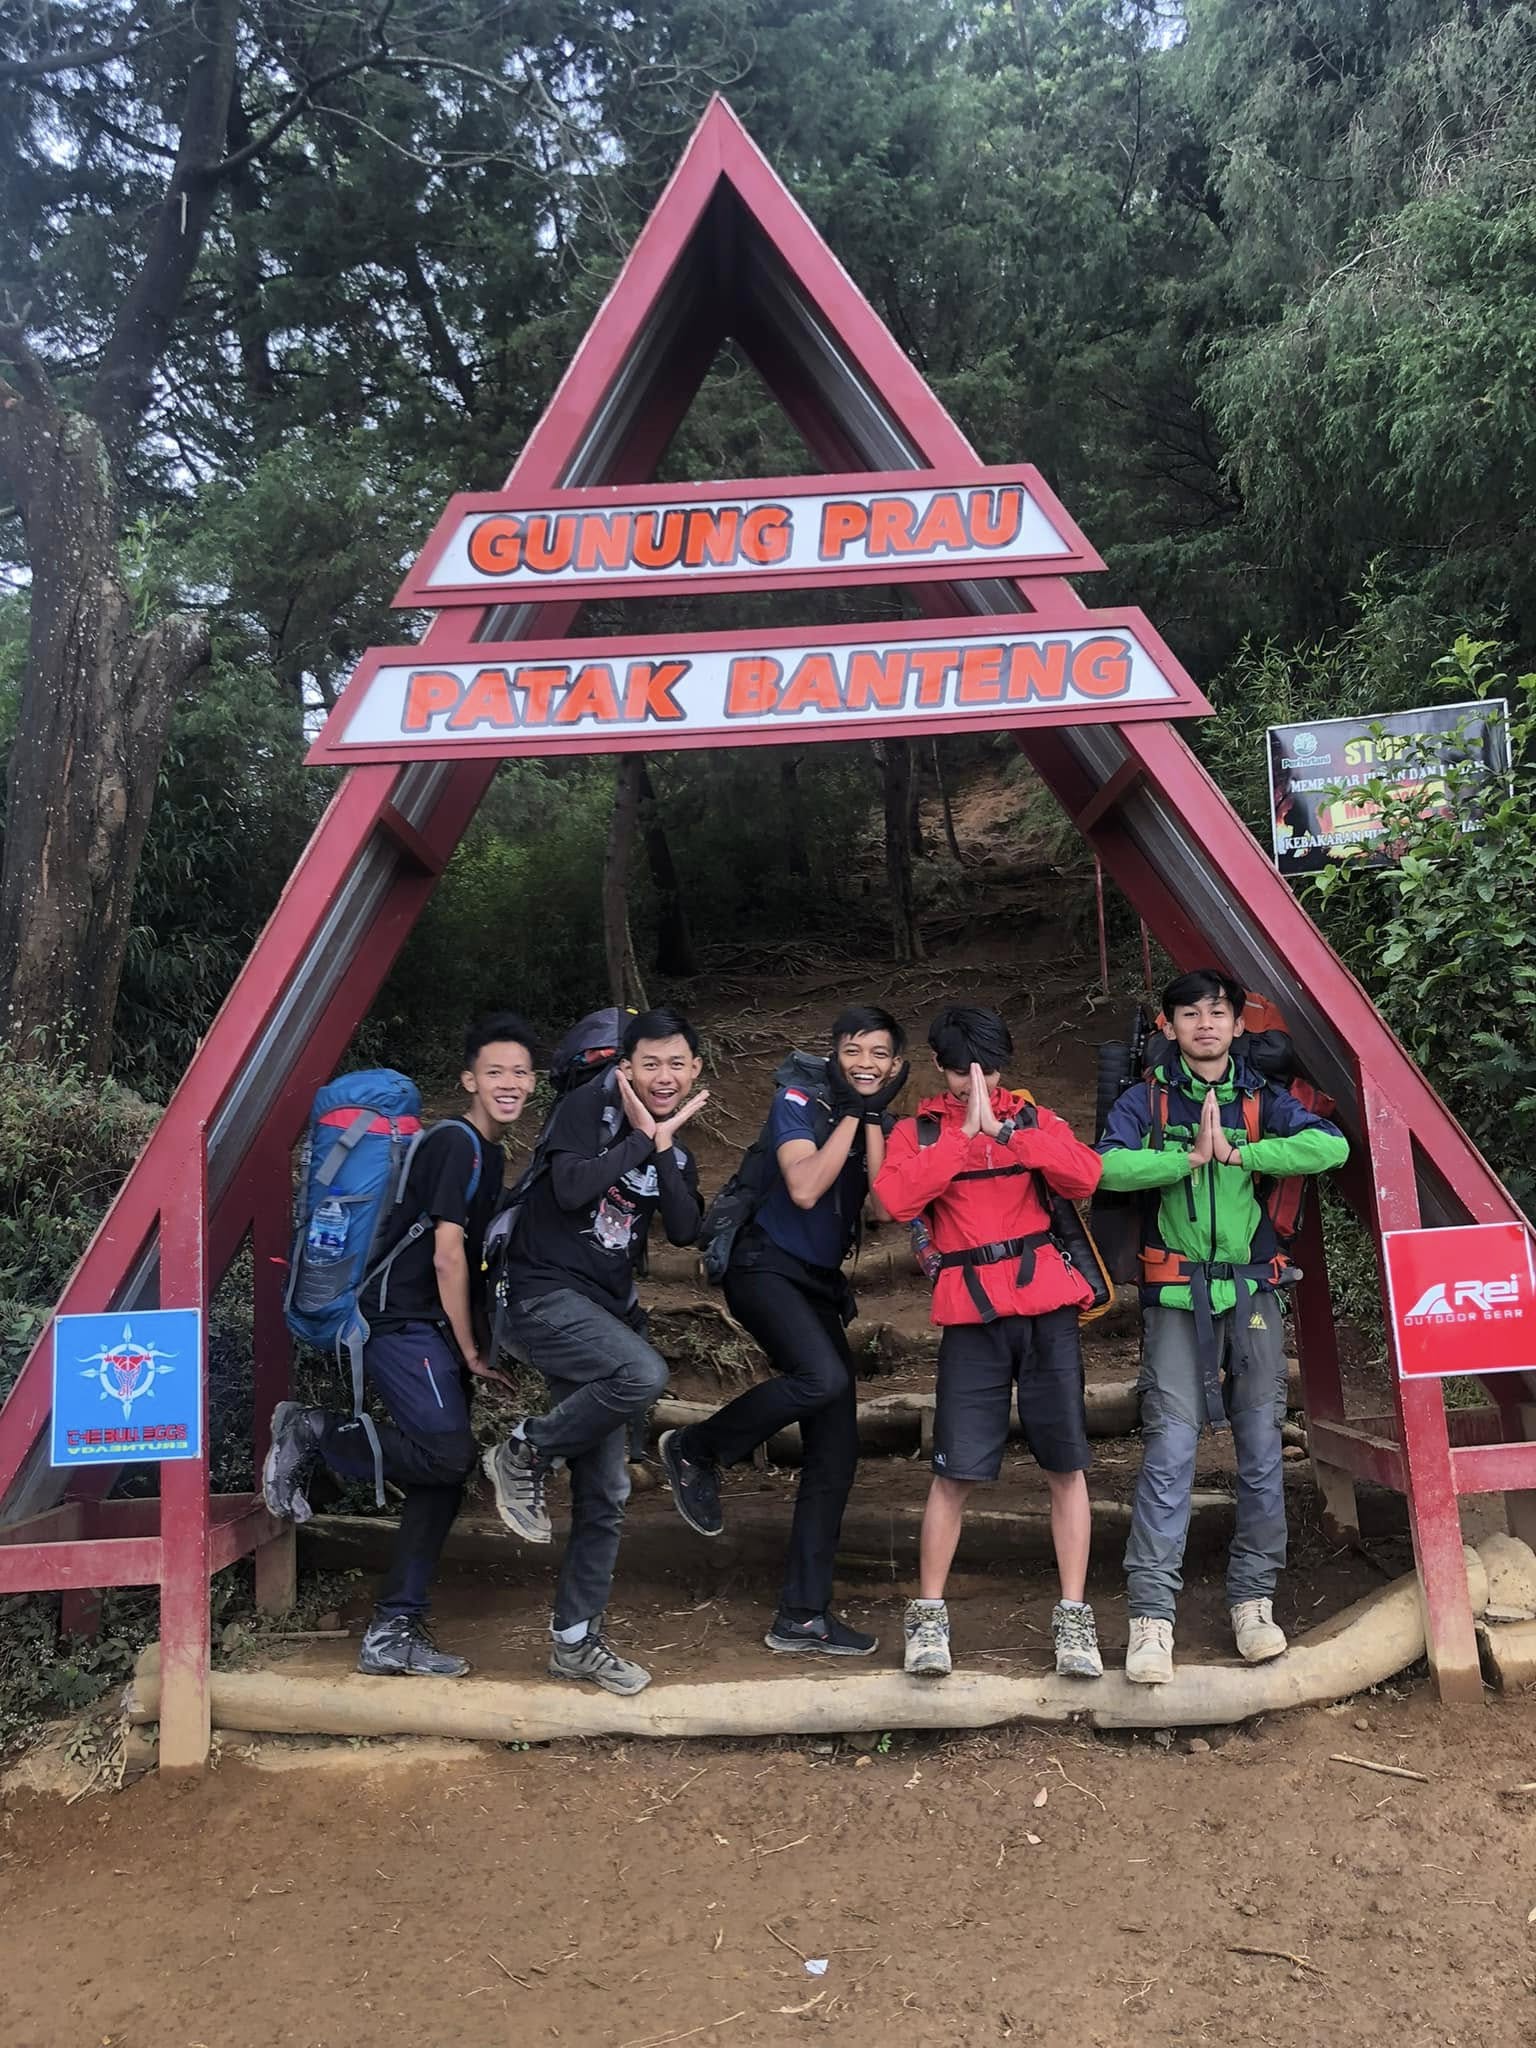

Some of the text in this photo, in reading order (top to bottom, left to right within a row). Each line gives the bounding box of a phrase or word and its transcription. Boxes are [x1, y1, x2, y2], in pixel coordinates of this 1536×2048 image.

[468, 487, 1024, 575] GUNUNG PRAU
[400, 635, 1131, 733] PATAK BANTENG
[1282, 754, 1332, 769] Perhutani
[1284, 830, 1362, 851] KEBAKARAN
[1455, 1273, 1519, 1311] Rei
[1404, 1308, 1524, 1327] OUTDOOR GEAR
[143, 1423, 187, 1441] EGGS
